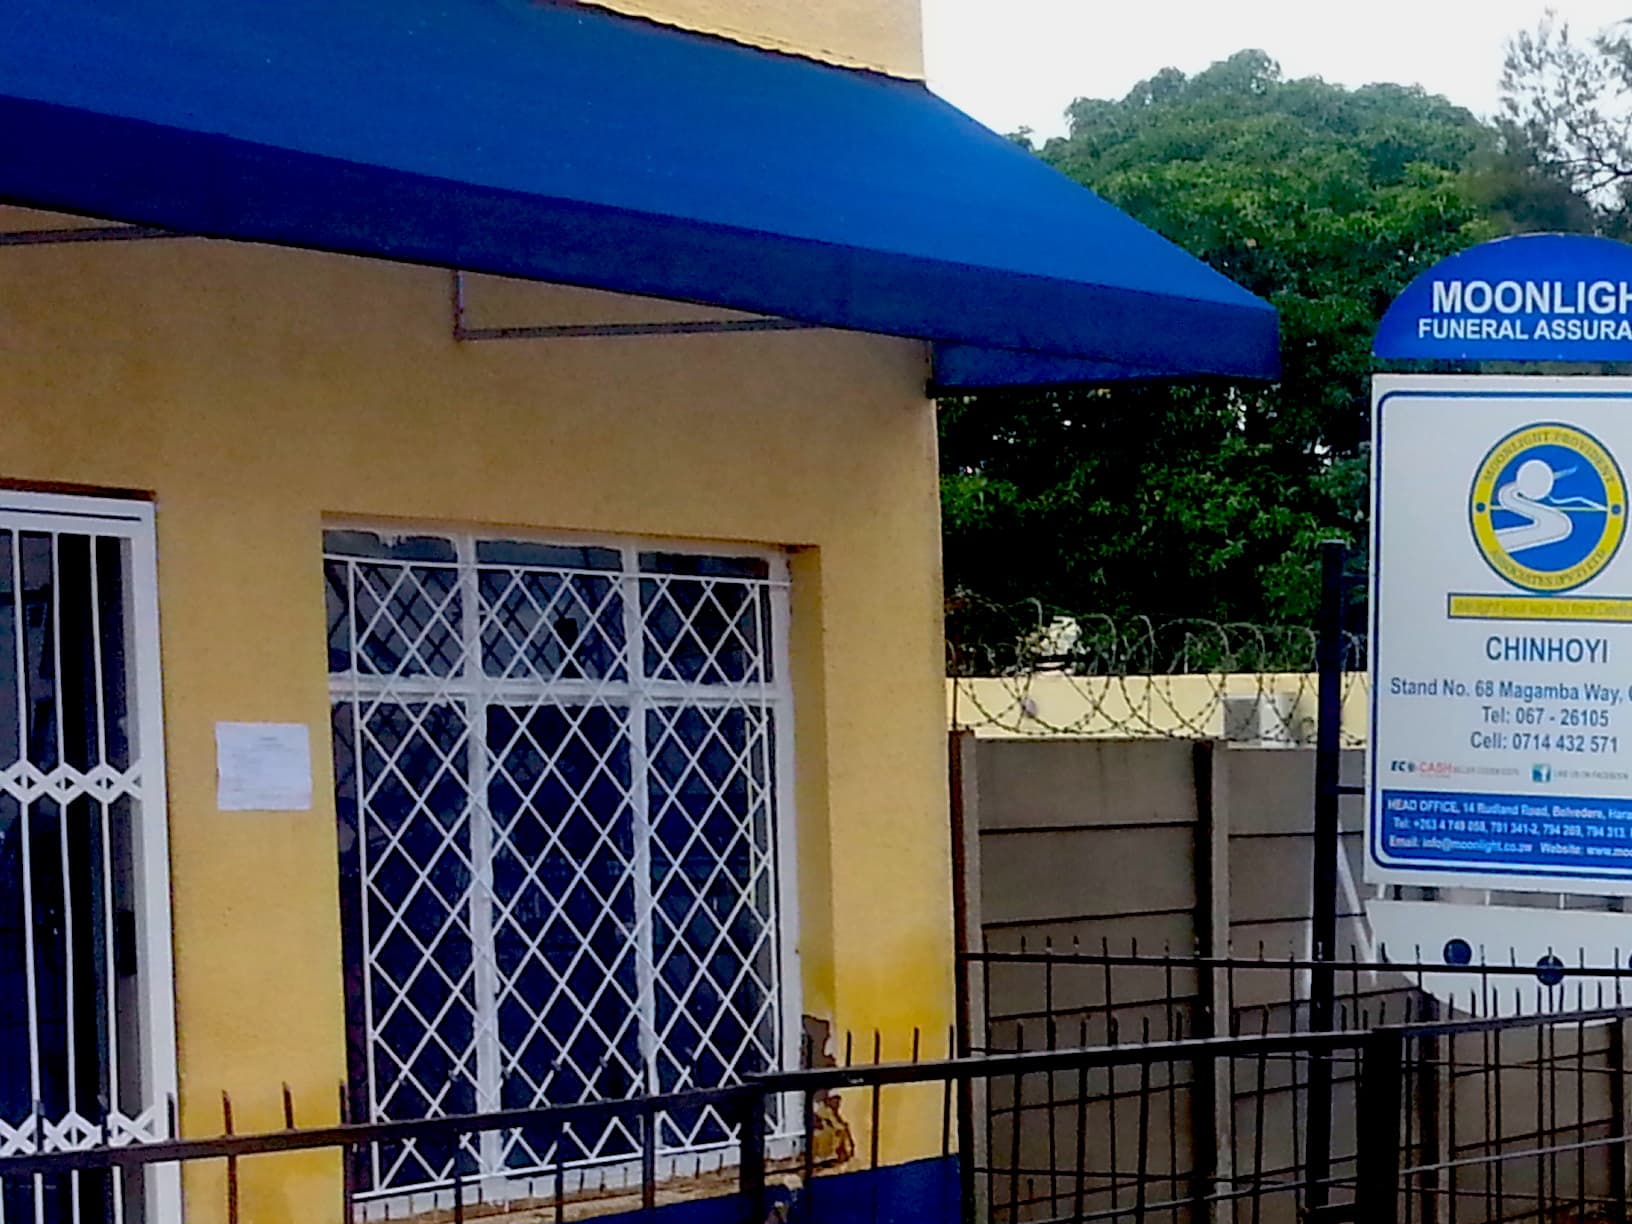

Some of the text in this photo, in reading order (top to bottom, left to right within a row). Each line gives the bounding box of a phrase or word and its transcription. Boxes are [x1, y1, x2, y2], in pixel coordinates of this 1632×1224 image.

[1418, 317, 1529, 341] FUNERAL
[1485, 636, 1609, 664] CHINHOYI
[1390, 677, 1438, 697] Stand
[1441, 679, 1470, 698] No.
[1474, 680, 1494, 698] 68
[1499, 681, 1580, 704] Magamba
[1583, 683, 1623, 705] Way,
[1482, 705, 1510, 724] Tel:
[1514, 707, 1545, 725] 067
[1560, 709, 1609, 728] 26105
[1470, 731, 1618, 753] Cell: 0714 432 571
[1388, 798, 1417, 811] HEAD
[1463, 802, 1475, 814] 14
